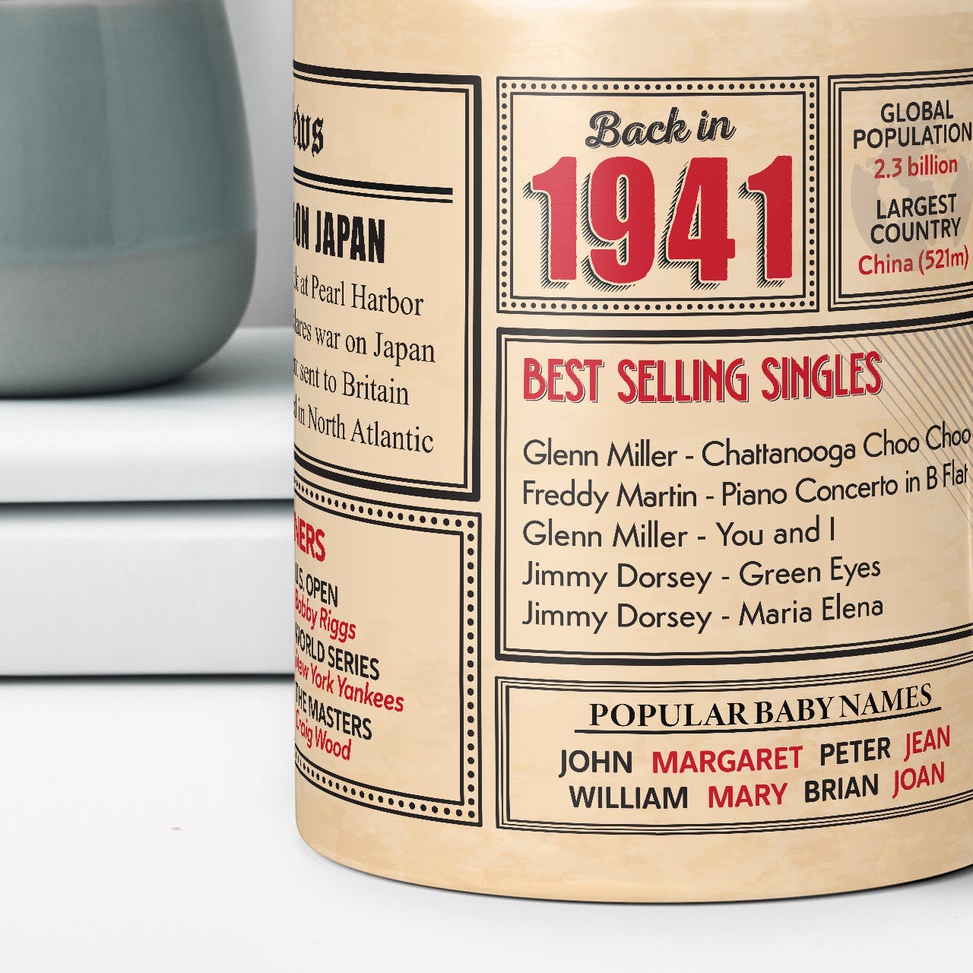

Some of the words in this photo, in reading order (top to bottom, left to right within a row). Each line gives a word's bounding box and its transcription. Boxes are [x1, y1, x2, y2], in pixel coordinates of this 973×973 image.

[585, 107, 692, 149] Back
[697, 110, 737, 142] in
[881, 100, 953, 123] GLOBAL
[854, 122, 972, 149] POPULATION
[874, 158, 902, 179] 2.3
[908, 154, 957, 176] billion
[522, 155, 792, 292] 1941
[877, 193, 957, 219] LARGEST
[296, 203, 309, 249] ON
[315, 210, 385, 263] JAPAN
[871, 217, 961, 244] COUNTRY
[859, 254, 913, 275] China
[919, 245, 968, 275] (521m)
[301, 275, 308, 296] at
[312, 274, 345, 306] Pearl
[351, 283, 424, 316] Harbor
[294, 309, 311, 341] lares
[315, 327, 340, 349] war
[346, 335, 367, 355] on
[374, 332, 435, 367] Japan
[300, 364, 319, 388] sent
[324, 370, 336, 393] to
[342, 371, 409, 405] Britain
[524, 358, 605, 403] BEST
[618, 358, 749, 404] SELLING
[762, 351, 883, 402] SINGLES
[298, 398, 305, 425] in
[308, 404, 346, 440] North
[350, 419, 433, 453] Atlantic
[524, 438, 598, 466] Glenn
[607, 439, 678, 467] Miller
[702, 438, 855, 468] Chattanooga
[863, 429, 919, 457] Choo
[926, 421, 971, 450] Choo
[524, 479, 609, 514] Freddy
[616, 482, 696, 507] Martin
[723, 482, 787, 506] Piano
[796, 476, 898, 503] Concerto
[906, 470, 920, 493] in
[927, 466, 937, 490] B
[943, 459, 968, 487] Flat
[523, 518, 601, 547] Glenn
[613, 520, 688, 547] Miller
[716, 522, 763, 546] You
[774, 515, 819, 544] and
[831, 517, 834, 541] I
[306, 573, 338, 607] OPEN
[522, 561, 608, 594] Jimmy
[618, 563, 712, 594] Dorsey
[740, 561, 820, 586] Green
[831, 556, 880, 586] Eyes
[320, 607, 356, 643] Riggs
[522, 601, 608, 634] Jimmy
[618, 603, 712, 634] Dorsey
[739, 600, 811, 626] Maria
[823, 593, 883, 620] Elena
[295, 622, 325, 662] WORLD
[328, 645, 380, 680] SERIES
[311, 662, 334, 694] York
[337, 674, 404, 712] Yankees
[589, 703, 749, 727] POPULAR
[754, 696, 834, 724] BABY
[840, 683, 933, 717] NAMES
[296, 682, 307, 713] THE
[309, 696, 372, 740] MASTERS
[296, 709, 313, 748] Craig
[315, 726, 351, 761] Wood
[559, 749, 632, 778] JOHN
[653, 746, 803, 773] MARGARET
[821, 737, 890, 766] PETER
[904, 725, 950, 762] JEAN
[569, 786, 687, 809] WILLIAM
[709, 783, 788, 808] MARY
[805, 774, 878, 803] BRIAN
[892, 762, 944, 799] JOAN
